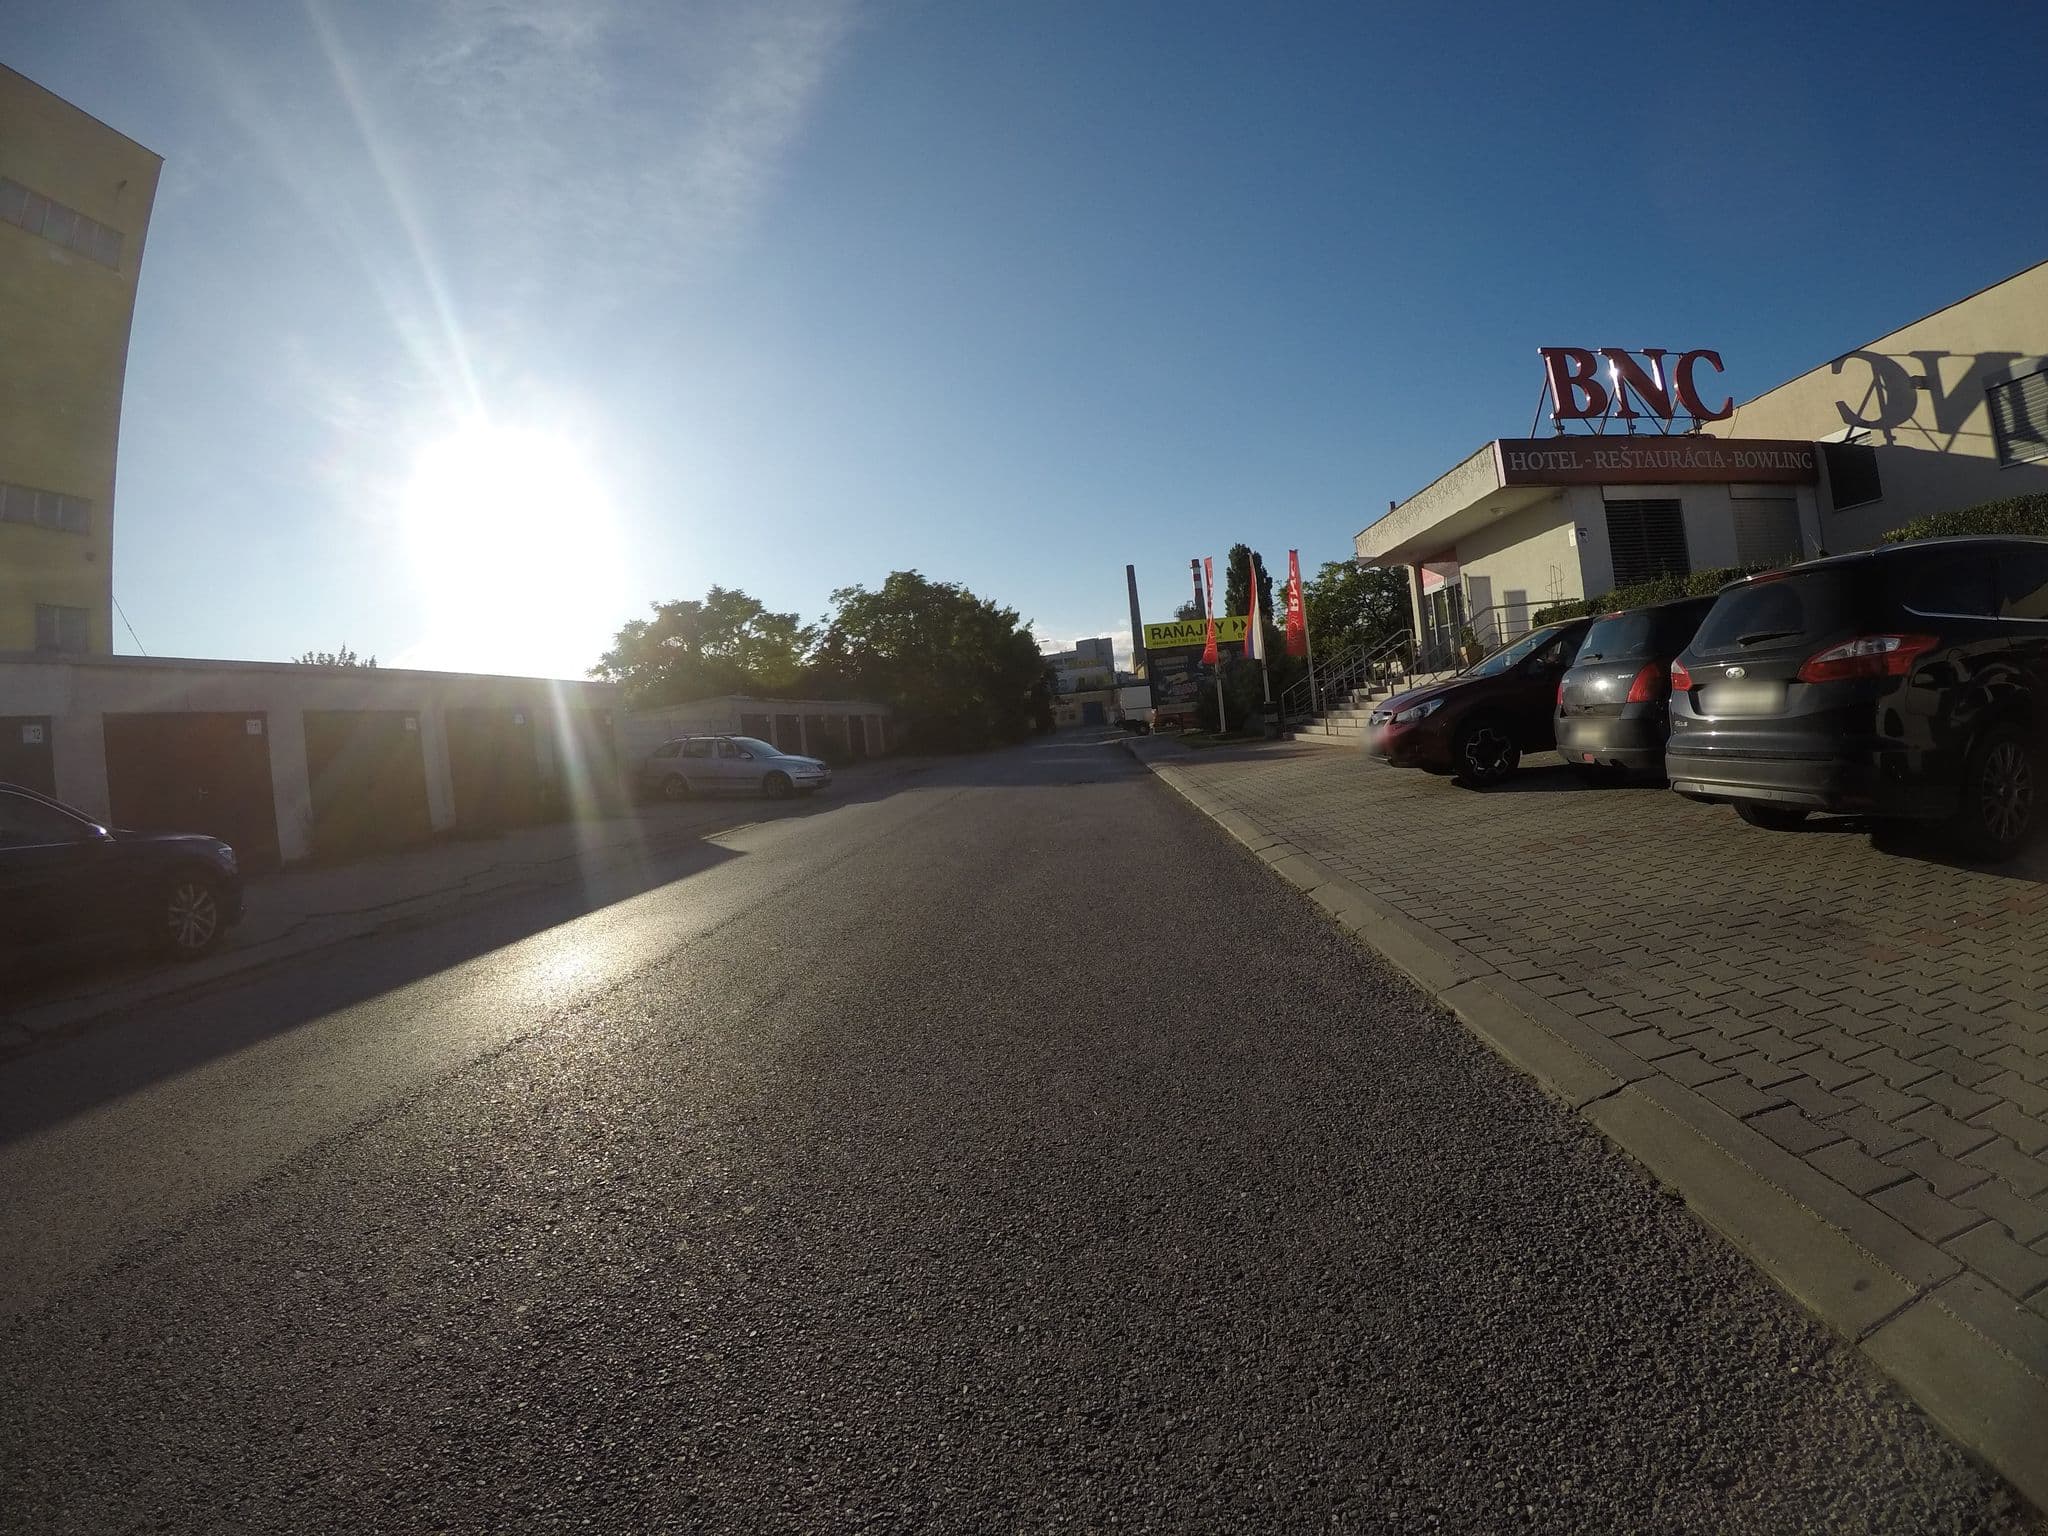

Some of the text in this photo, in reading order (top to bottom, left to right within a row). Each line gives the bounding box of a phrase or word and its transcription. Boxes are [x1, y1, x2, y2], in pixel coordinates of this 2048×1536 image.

[1537, 347, 1733, 421] BNC
[1510, 450, 1583, 471] HOTEL
[1733, 450, 1815, 470] BOWLING
